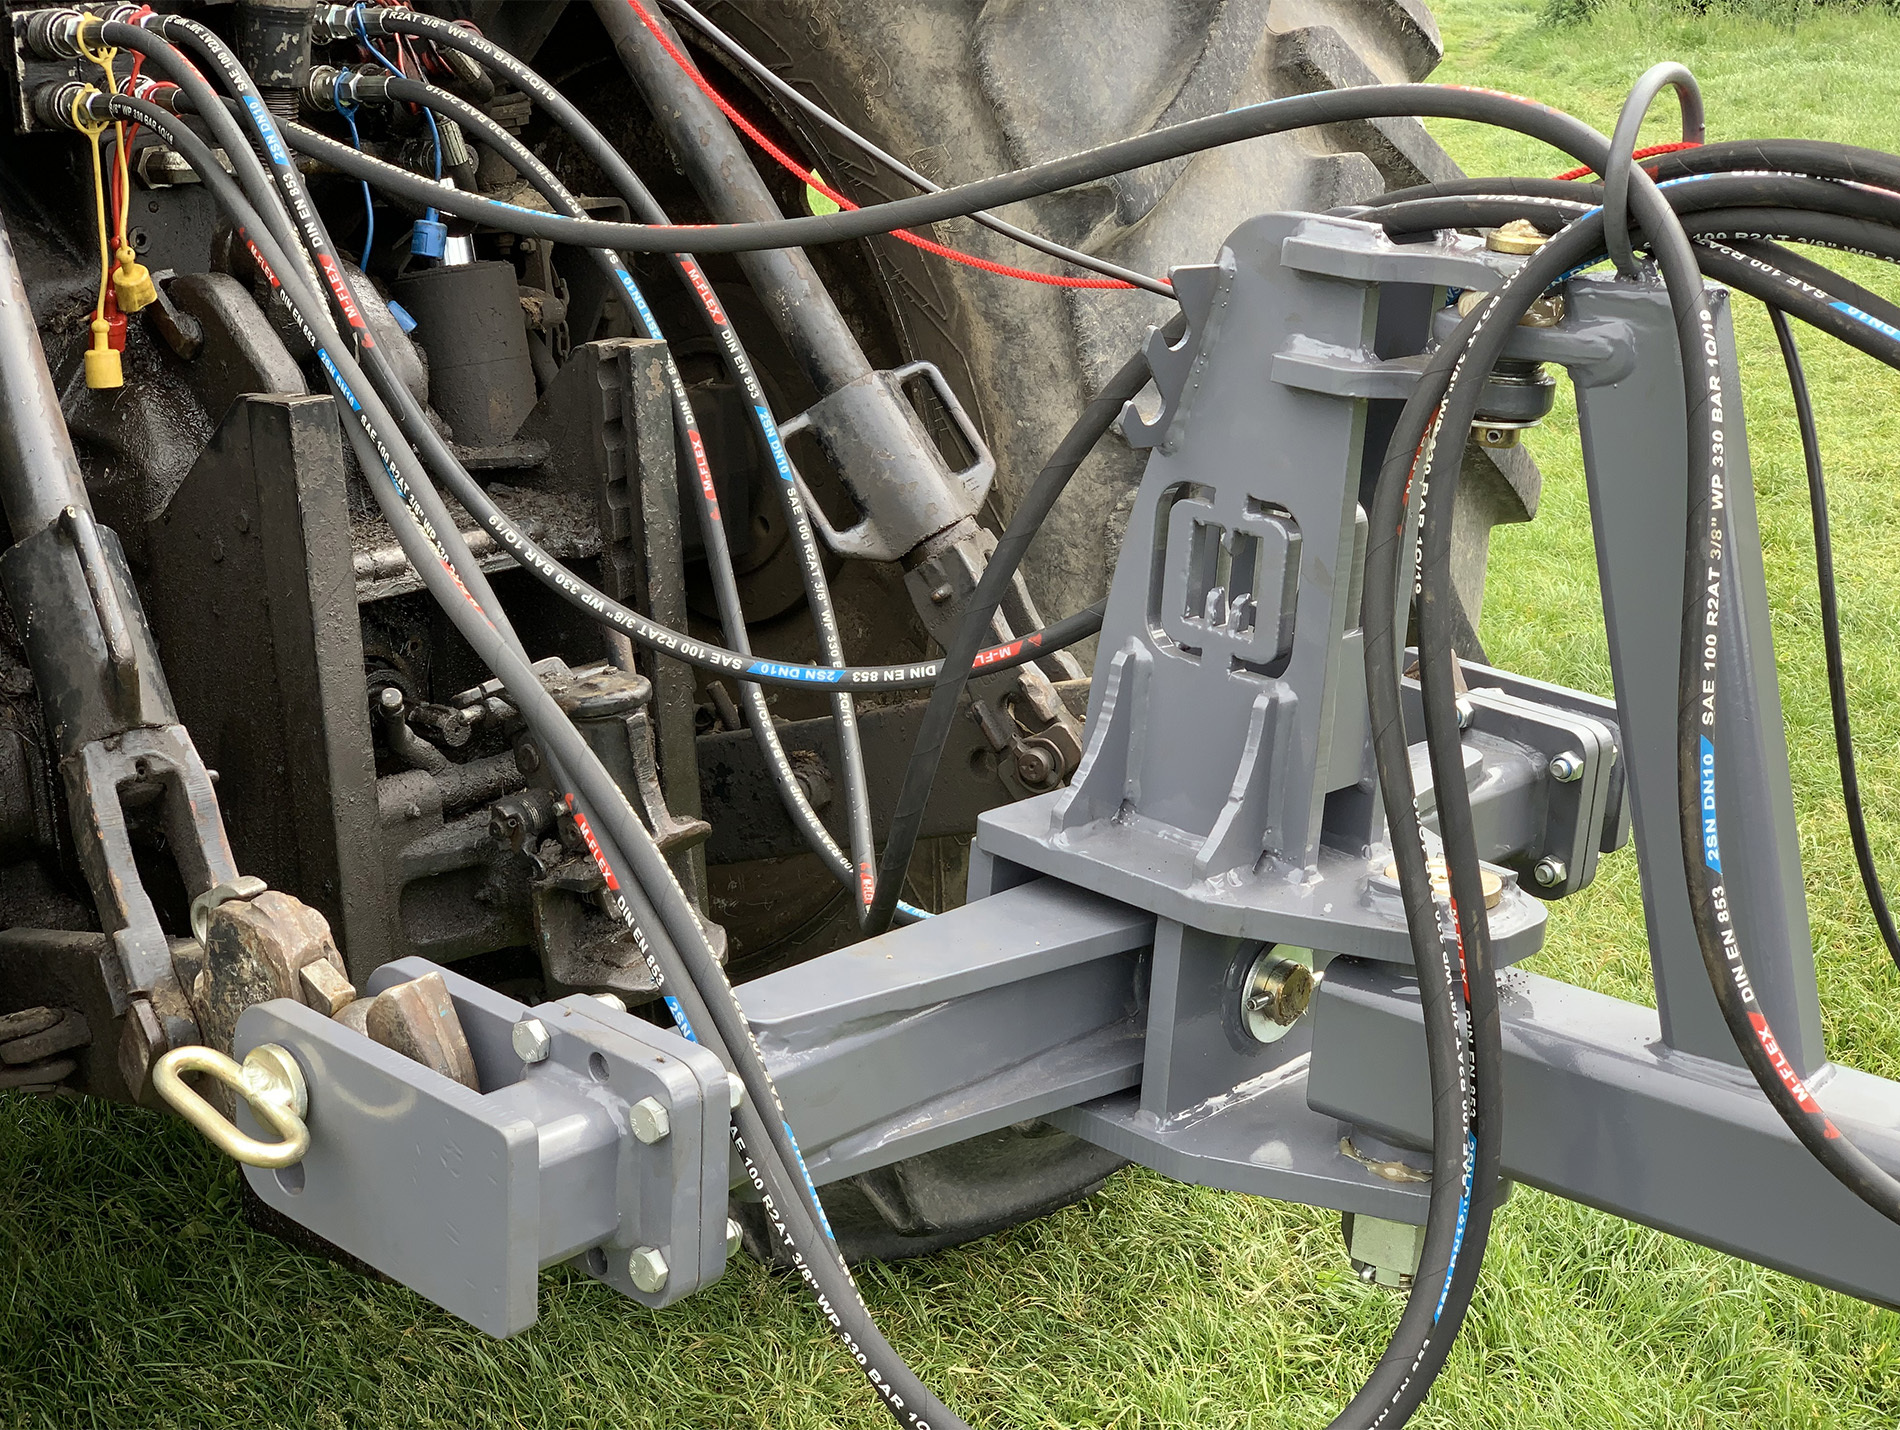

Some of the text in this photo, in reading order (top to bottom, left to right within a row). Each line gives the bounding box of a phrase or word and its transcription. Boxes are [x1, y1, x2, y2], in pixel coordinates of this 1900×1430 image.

[199, 32, 222, 54] R2AT
[389, 11, 421, 22] R2AT
[448, 26, 470, 39] WP
[470, 38, 492, 54] 330
[493, 51, 522, 74] BAR
[522, 72, 556, 101] 2Q/19
[217, 52, 233, 69] 100
[228, 69, 248, 92] SAE
[122, 104, 132, 116] WP
[144, 114, 156, 131] BAR
[250, 102, 270, 132] DN10
[461, 105, 486, 124] BAR
[488, 122, 512, 141] 330
[266, 135, 285, 159] 2SN
[510, 141, 529, 160] WP
[282, 172, 300, 197] 853
[294, 199, 311, 220] EN
[550, 184, 582, 214] R2AT
[304, 222, 323, 248] DIN
[324, 263, 357, 318] M-FLEX
[624, 276, 646, 310] DN10
[688, 268, 721, 317] M-FLEX
[1786, 276, 1828, 299] SAE
[1847, 306, 1897, 336] DN10
[721, 329, 739, 354] DIN
[1700, 309, 1719, 368] 1Q/19
[734, 355, 749, 375] EN
[672, 378, 685, 398] EN
[744, 376, 760, 399] 853
[1709, 375, 1724, 423] BAR
[680, 401, 694, 424] DIN
[759, 411, 775, 439] 2SN
[771, 440, 789, 474] DN10
[1712, 429, 1724, 468] 330
[692, 440, 714, 492] M-FLEX
[786, 487, 803, 516] SAE
[1711, 474, 1724, 510] WP
[488, 514, 523, 550] 1Q/19
[797, 518, 810, 541] 100
[524, 548, 556, 577] BAR
[804, 544, 822, 577] R2AT
[555, 574, 581, 595] 330
[1706, 567, 1720, 626] R2AT
[580, 594, 605, 613] WP
[821, 610, 834, 631] WP
[637, 624, 678, 650] R2AT
[826, 635, 840, 658] 330
[680, 643, 706, 660] 100
[709, 652, 744, 670] SAE
[1704, 633, 1718, 671] 100
[760, 664, 800, 679] DN10
[804, 669, 836, 682] 2SN
[852, 671, 879, 683] 853
[883, 670, 905, 682] EN
[910, 665, 937, 679] DIN
[839, 692, 853, 728] 2Q/19
[1702, 680, 1716, 726] SAE
[765, 728, 784, 758] BAR
[778, 762, 794, 782] 330
[1702, 754, 1716, 810] DN10
[790, 785, 806, 806] WP
[816, 828, 842, 857] R2AT
[1704, 820, 1720, 862] 2SN
[1712, 885, 1730, 923] 853
[580, 822, 691, 1038] M-FLEX DIN EN 853 2SN
[1720, 930, 1741, 960] EN
[1731, 966, 1755, 1004] DIN
[1757, 1026, 1810, 1103] M-FLEX
[730, 1115, 746, 1152] AE
[744, 1156, 765, 1190] 100
[762, 1194, 795, 1247] R2AT
[817, 1294, 841, 1328] WP
[840, 1332, 868, 1366] 330
[867, 1367, 905, 1411] BAR
